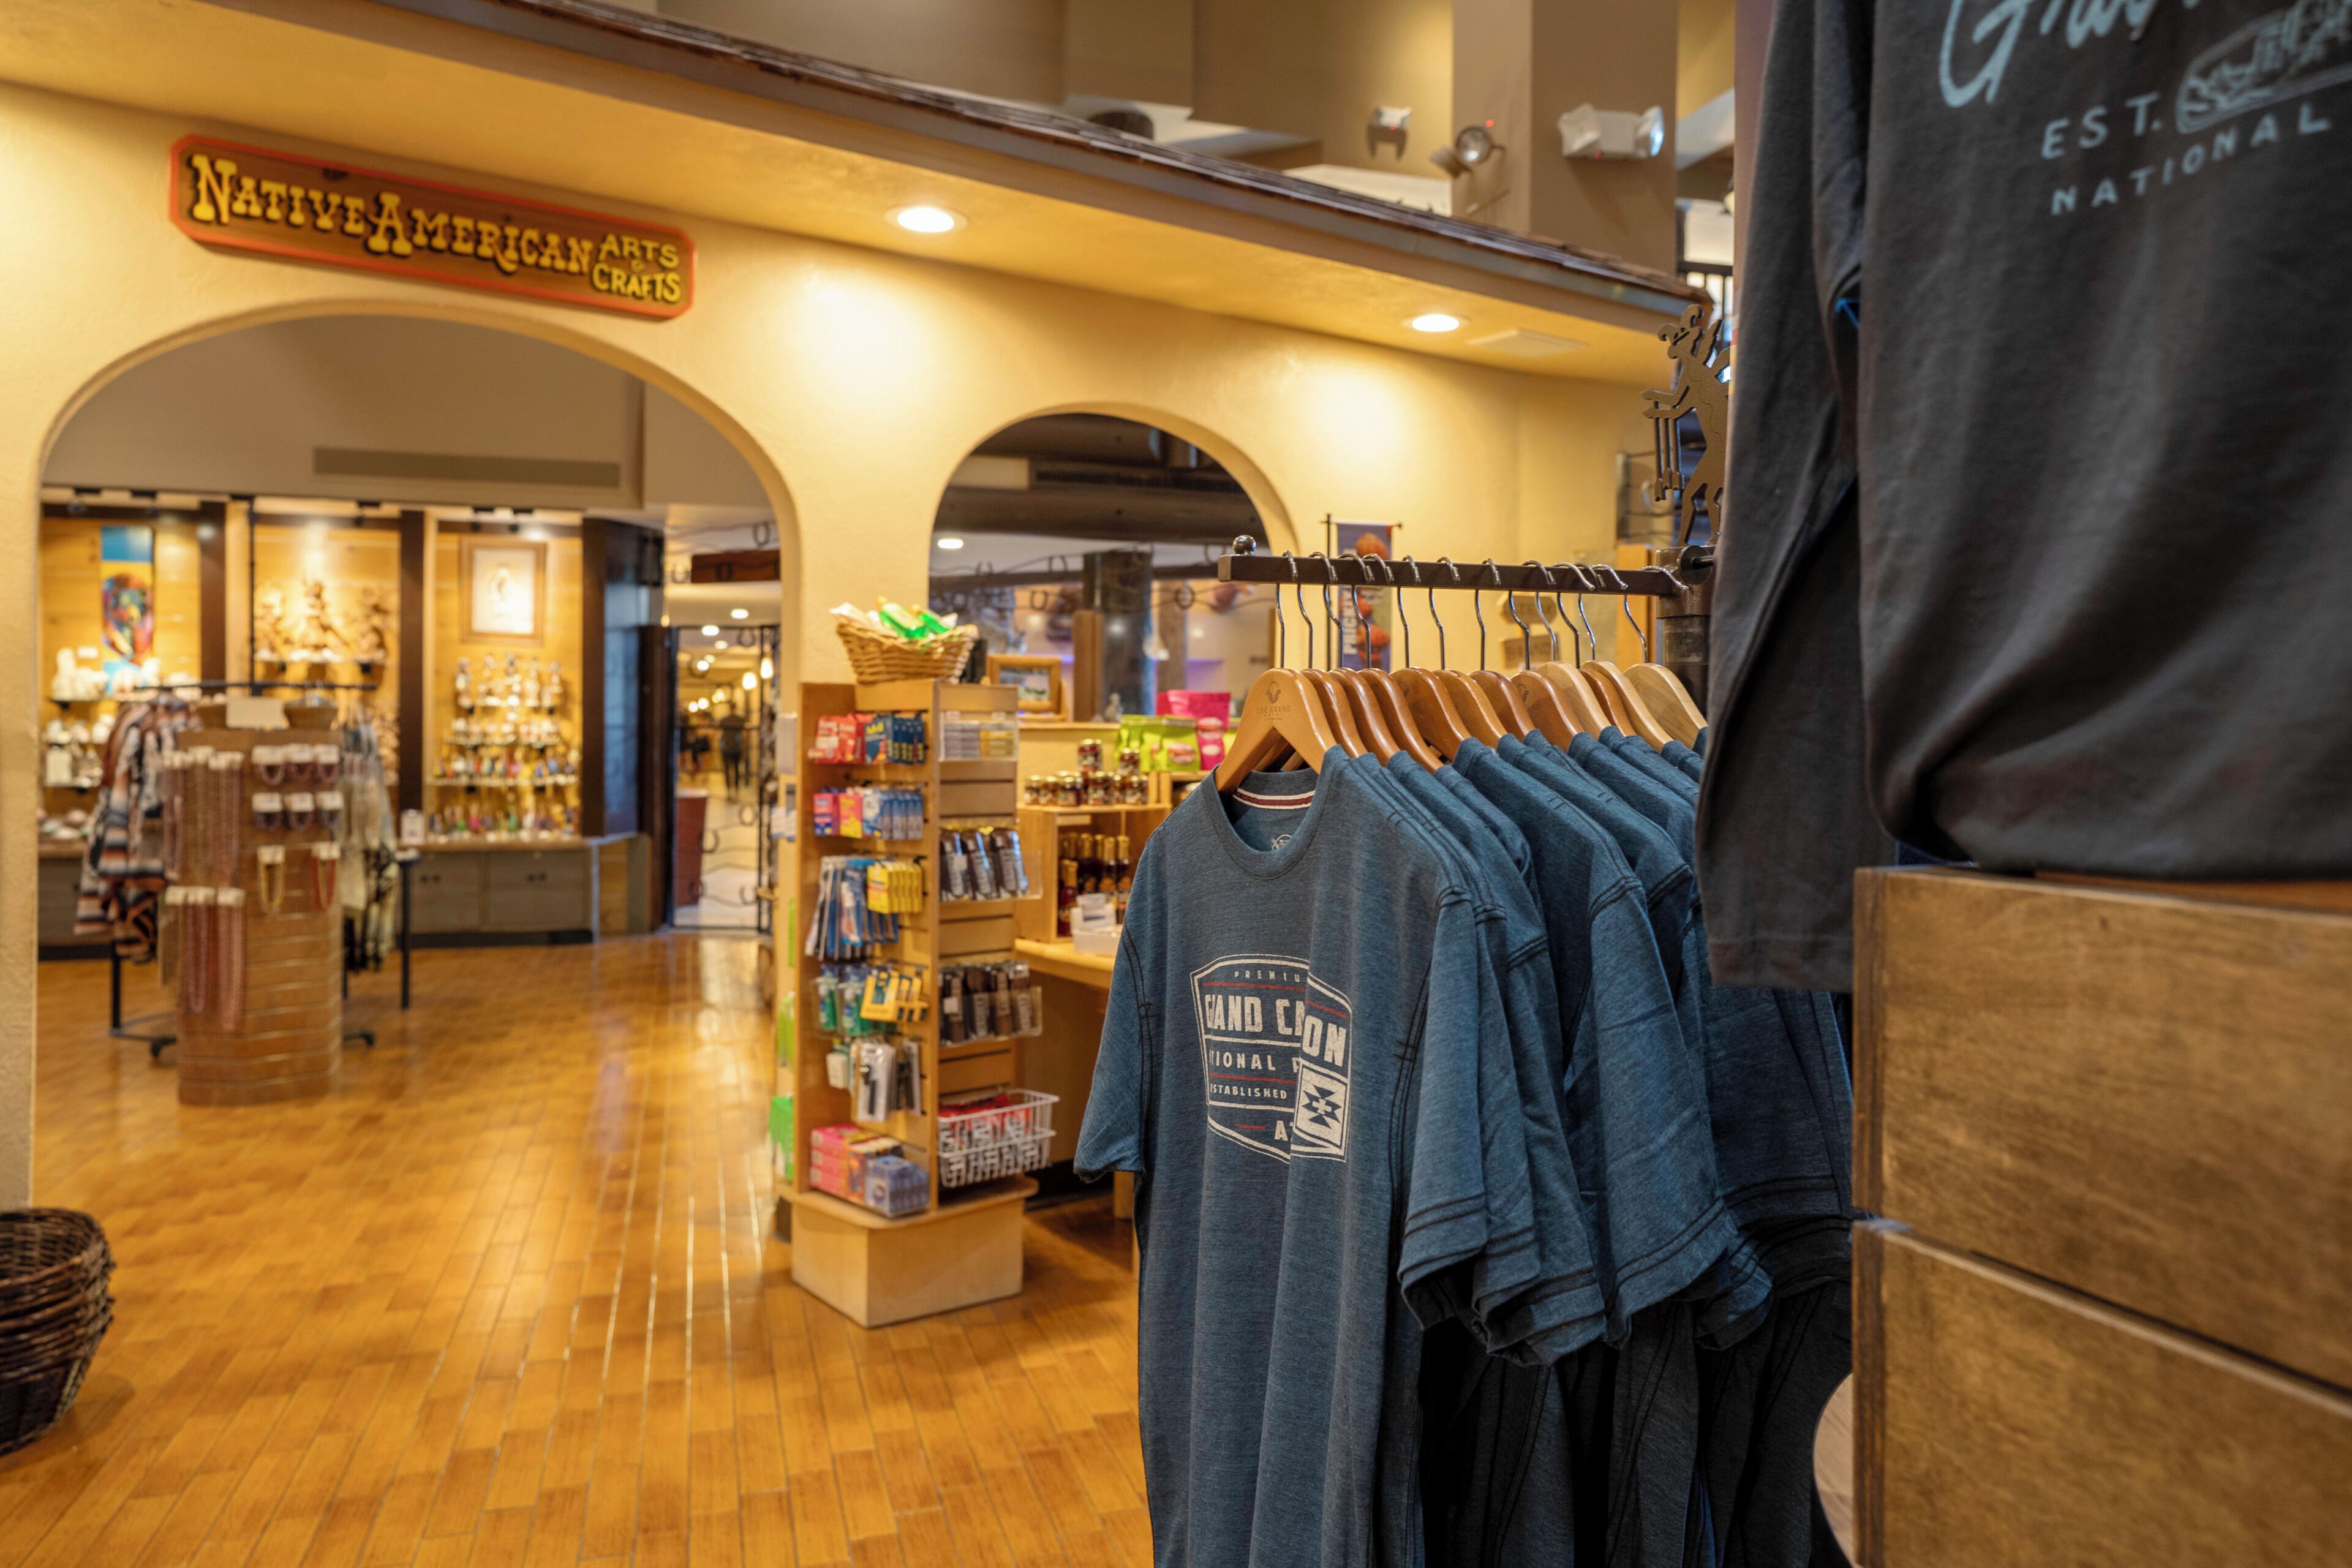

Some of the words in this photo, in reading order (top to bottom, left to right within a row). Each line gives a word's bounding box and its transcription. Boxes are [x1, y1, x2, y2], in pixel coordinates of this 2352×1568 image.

[2041, 92, 2162, 159] EST.
[2051, 102, 2330, 216] NATIONAL
[192, 154, 364, 235] NATIVE
[368, 190, 593, 274] AMERICAN
[598, 233, 679, 268] ARTS
[592, 263, 681, 303] CRAFTS
[1234, 970, 1300, 982] PREMIU
